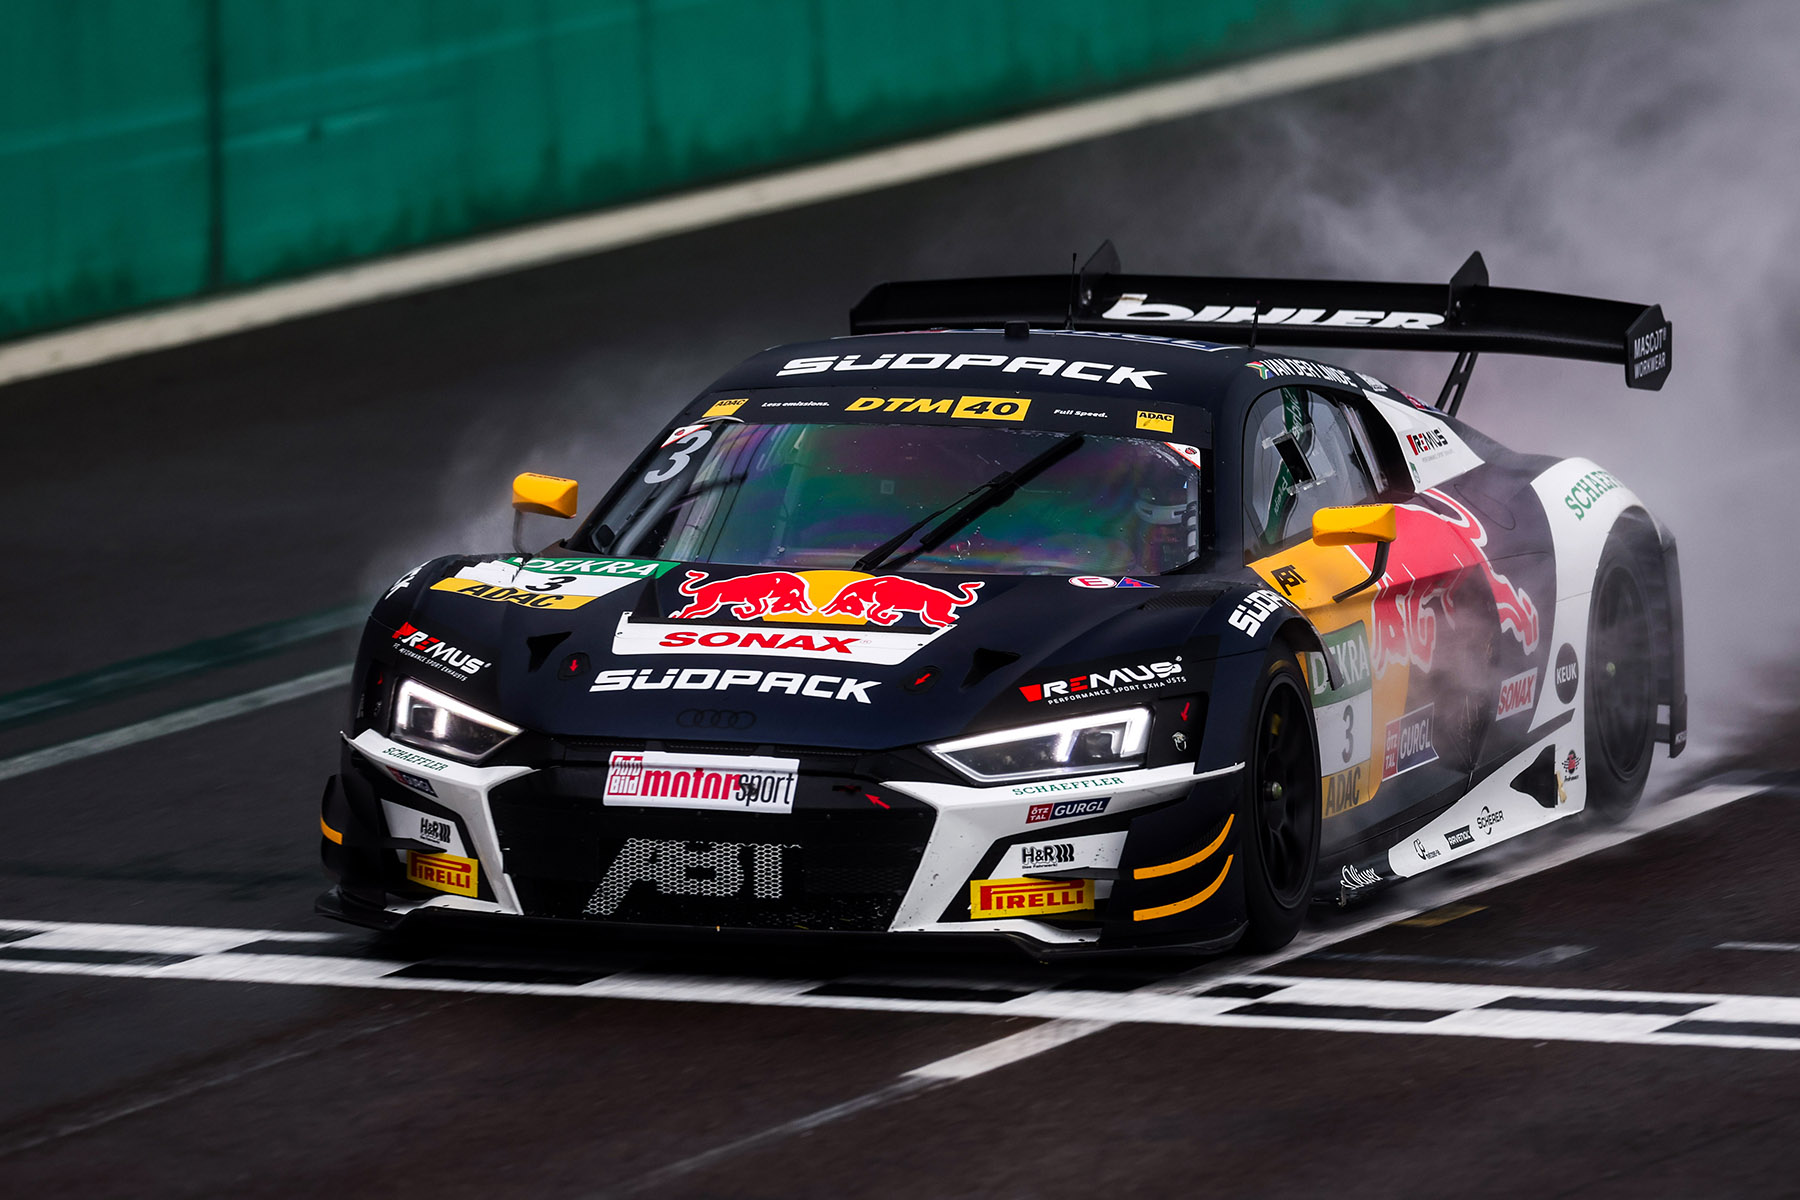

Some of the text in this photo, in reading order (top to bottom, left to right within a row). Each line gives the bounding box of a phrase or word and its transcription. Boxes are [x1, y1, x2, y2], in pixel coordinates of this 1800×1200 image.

[776, 353, 1168, 390] SÜDPACK
[1260, 358, 1295, 376] VAN
[1284, 358, 1321, 378] DER
[1313, 363, 1358, 388] LINDE
[715, 399, 745, 408] ADAC
[845, 397, 1020, 416] DTM 40
[1074, 410, 1108, 418] Speed.
[1139, 411, 1173, 422] ADAC
[1411, 428, 1448, 454] REMUS
[643, 430, 713, 484] 3
[525, 576, 577, 592] 3
[1270, 564, 1307, 596] ABT
[458, 583, 565, 608] ADAC
[400, 630, 485, 675] REMUS
[659, 631, 863, 654] SONAX
[1042, 660, 1183, 698] REMUS
[1310, 634, 1370, 696] DKRA
[589, 668, 882, 704] SÜDPACK
[1048, 676, 1187, 705] PERFORMANCE SPORT EXHAUSTS
[1497, 674, 1535, 715] SONAX
[1342, 704, 1354, 764] 3
[1400, 718, 1430, 760] GURGL
[382, 746, 449, 772] SCHAEFFLER
[1012, 776, 1125, 796] SCHAEFFLER
[1325, 766, 1361, 817] ADAC
[1031, 806, 1049, 815] ÖTZ
[1054, 800, 1104, 816] GURGL
[1022, 845, 1056, 864] H&R
[410, 853, 472, 889] PIRELLI
[980, 879, 1086, 911] PIRELLI
